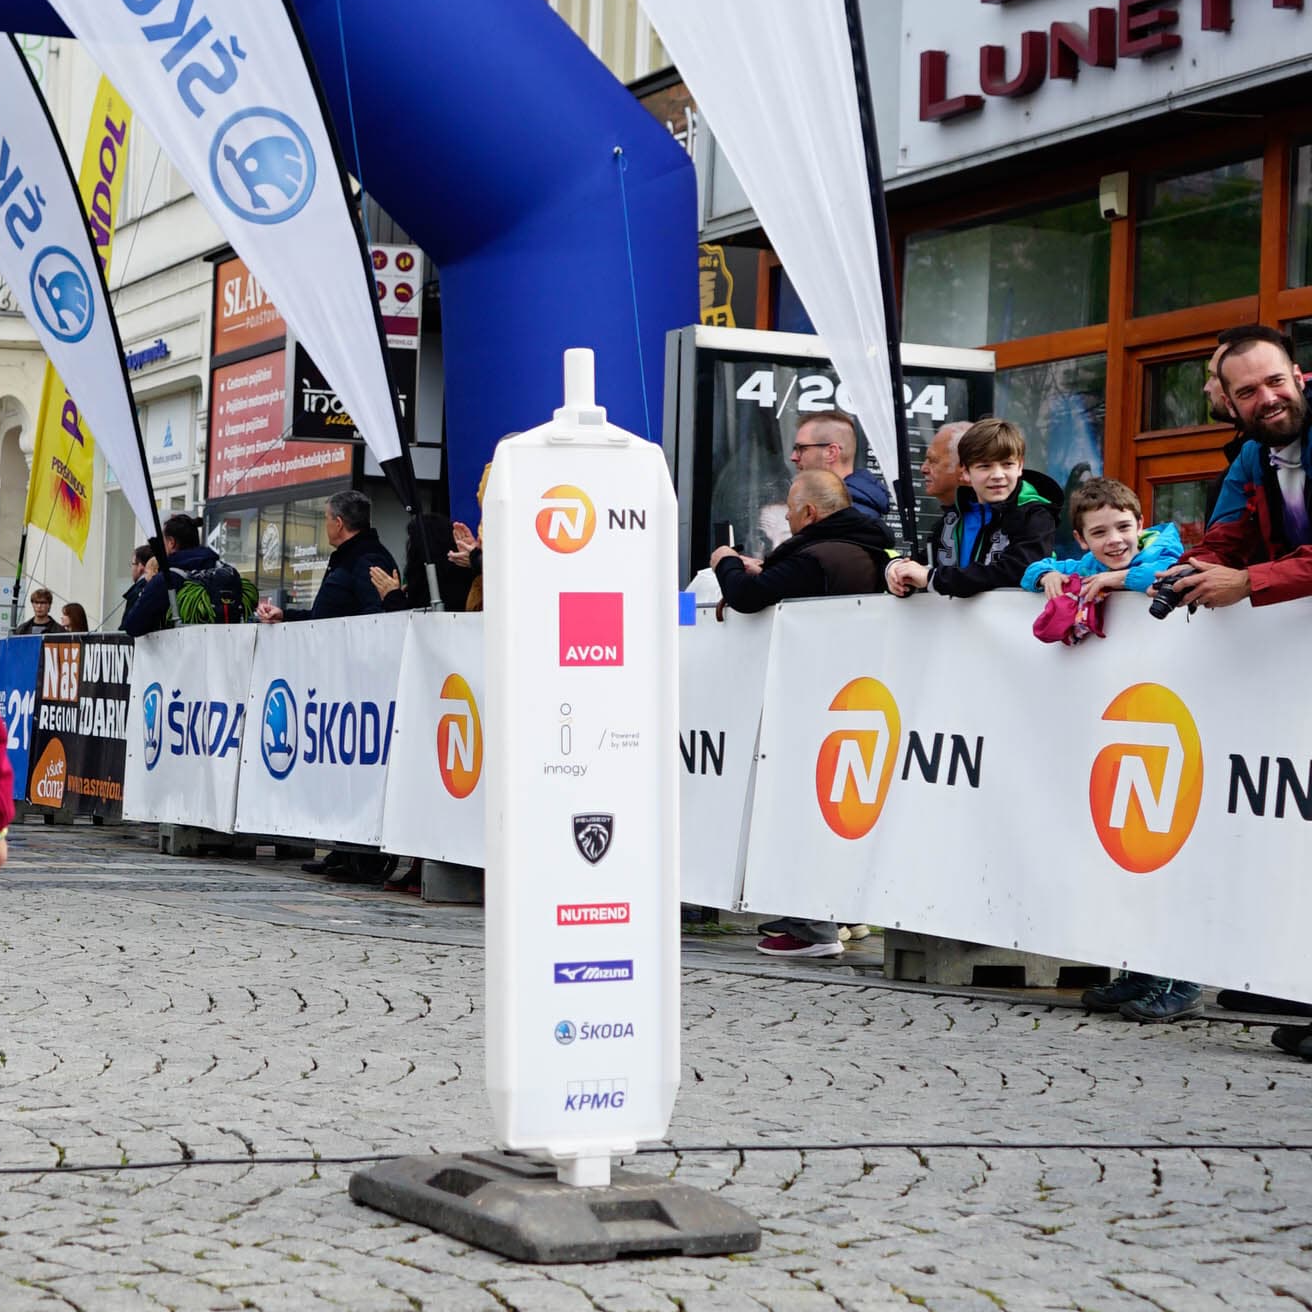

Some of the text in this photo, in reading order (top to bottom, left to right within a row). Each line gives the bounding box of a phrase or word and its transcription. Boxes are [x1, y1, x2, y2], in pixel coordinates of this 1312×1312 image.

[736, 370, 949, 421] 4/24
[607, 508, 646, 530] NN
[565, 645, 617, 661] AVON
[42, 646, 79, 700] Náš
[39, 705, 78, 734] REGION
[543, 762, 588, 777] innogy
[901, 730, 985, 788] NN
[574, 816, 612, 824] PEUGEOT
[560, 906, 627, 923] NUTREND
[579, 1021, 634, 1040] ŠKODA
[564, 1091, 625, 1112] KPMG
